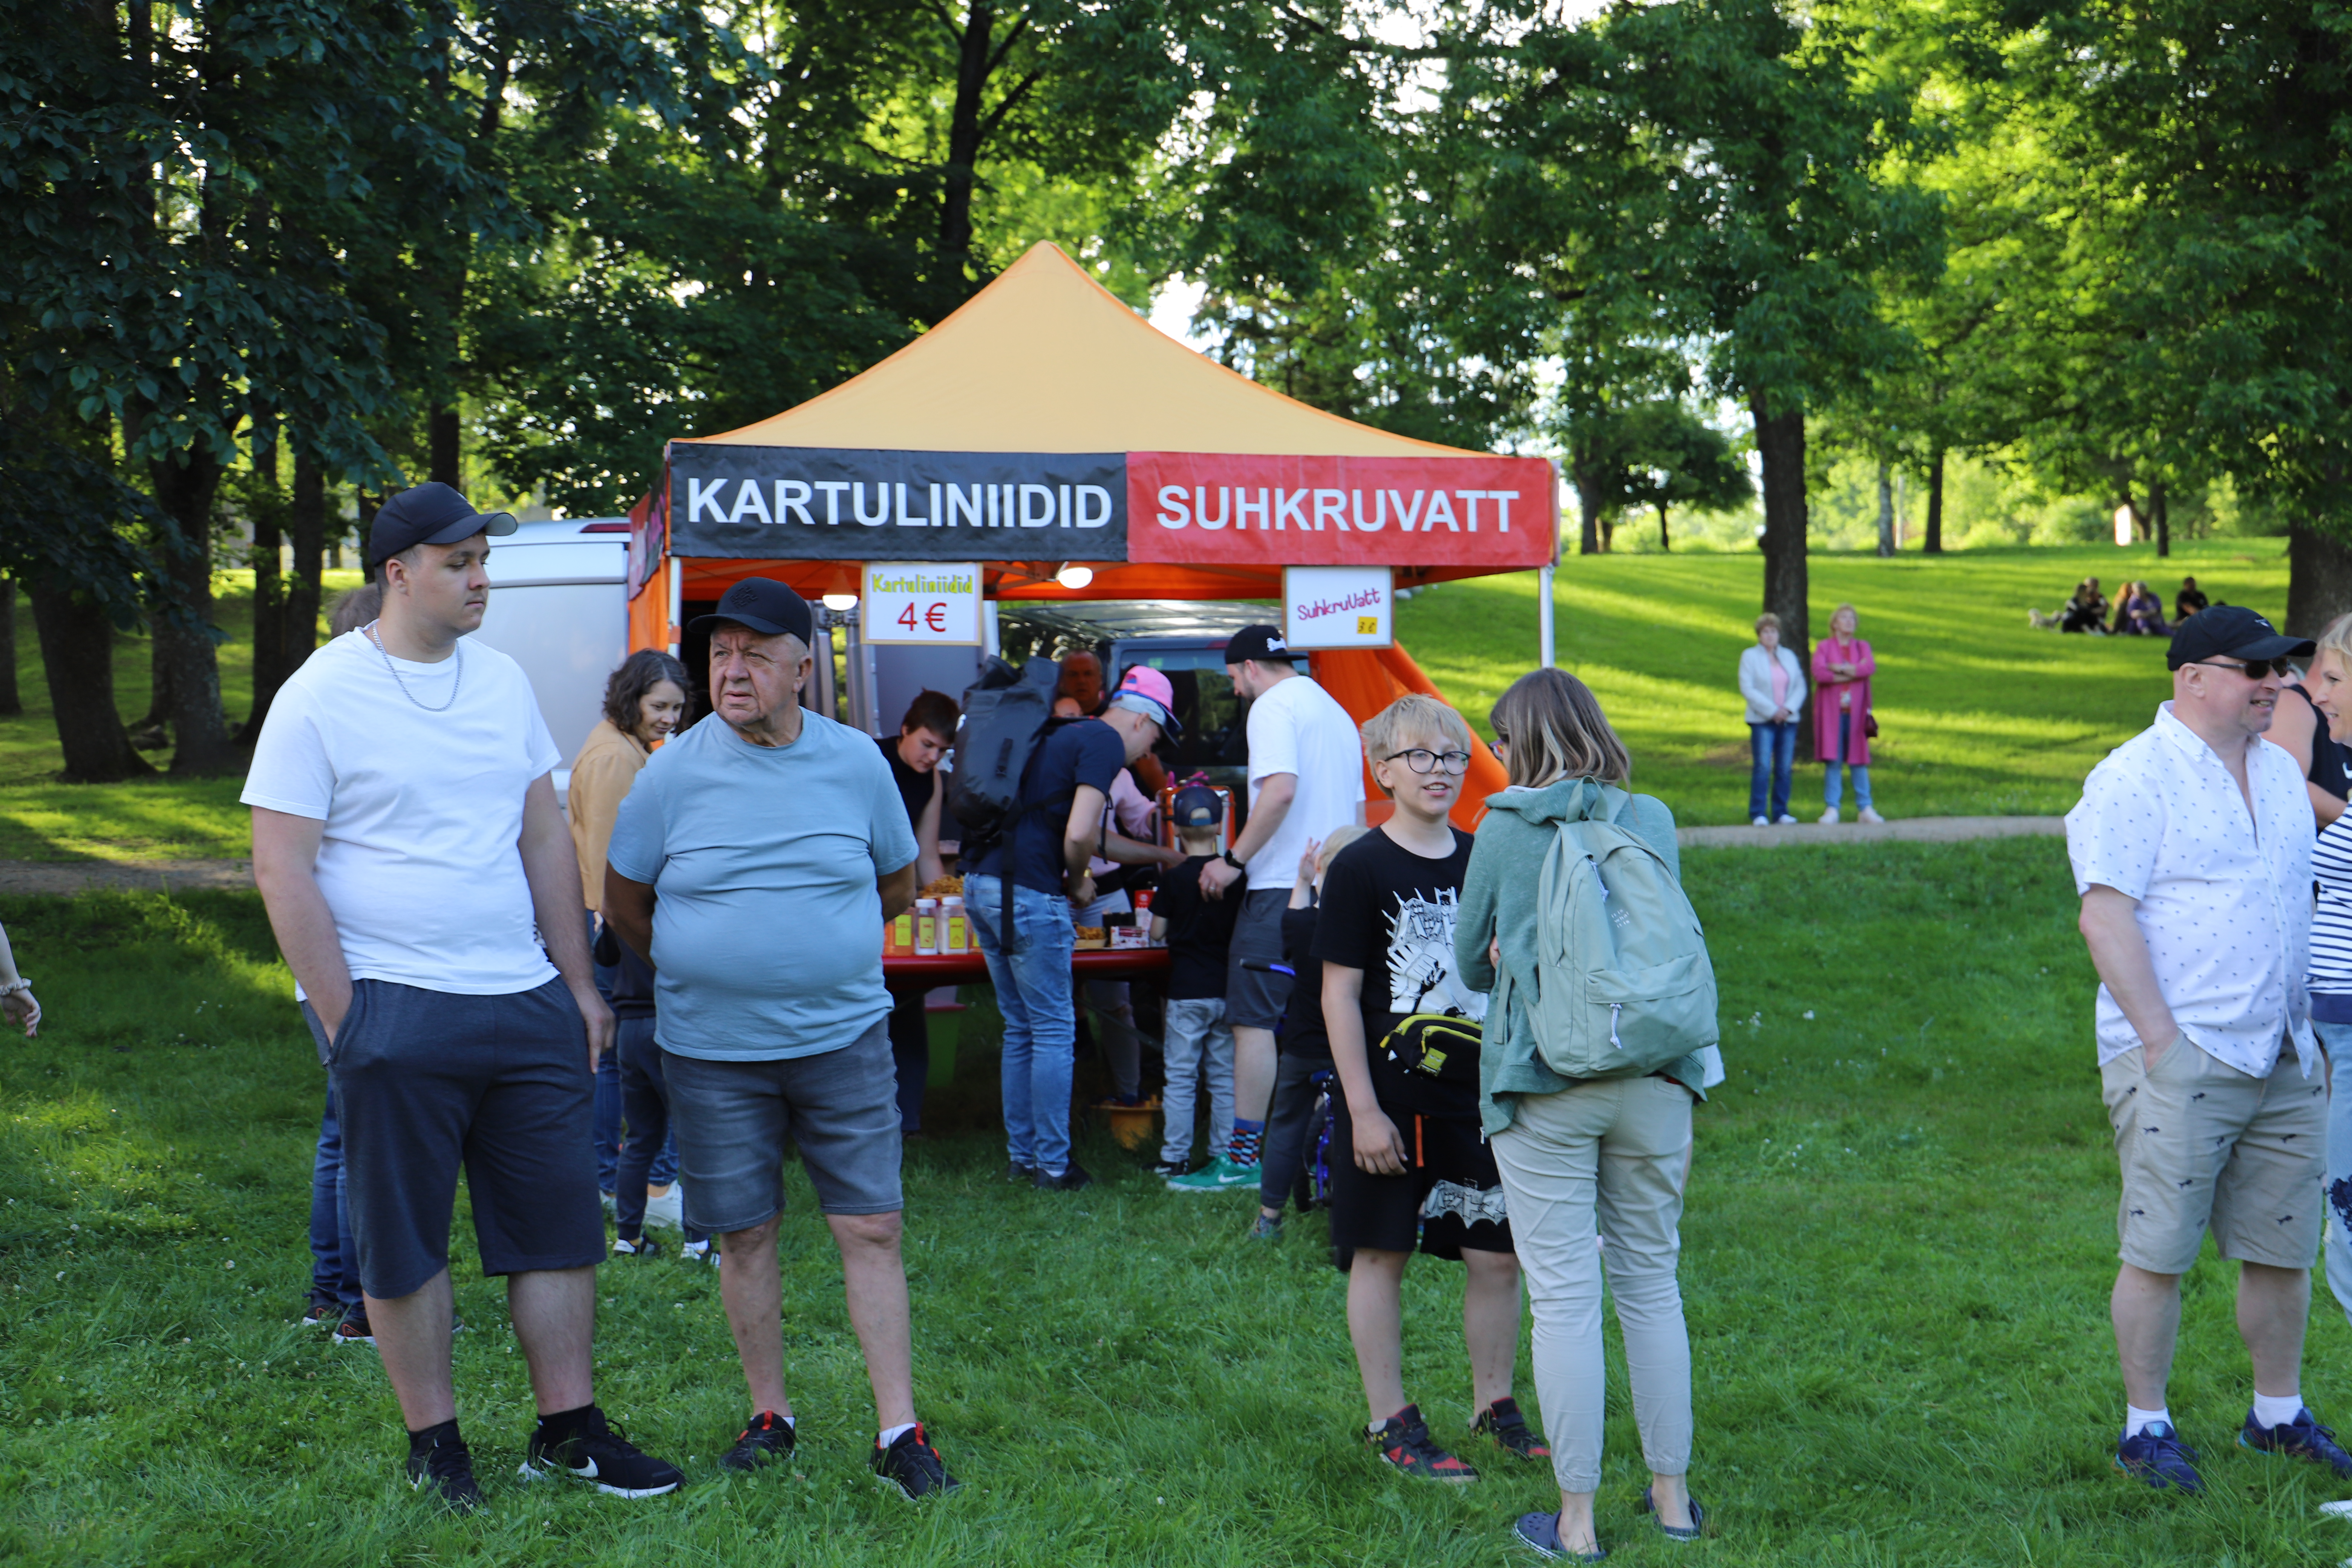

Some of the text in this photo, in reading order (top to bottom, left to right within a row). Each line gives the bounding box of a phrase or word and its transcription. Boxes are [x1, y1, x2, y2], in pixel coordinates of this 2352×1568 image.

[688, 478, 1112, 528] KARTULINIIDID
[1156, 485, 1519, 533] SUHKRUVATT
[873, 574, 973, 593] Kartuliniidid
[1614, 911, 1629, 923] what
